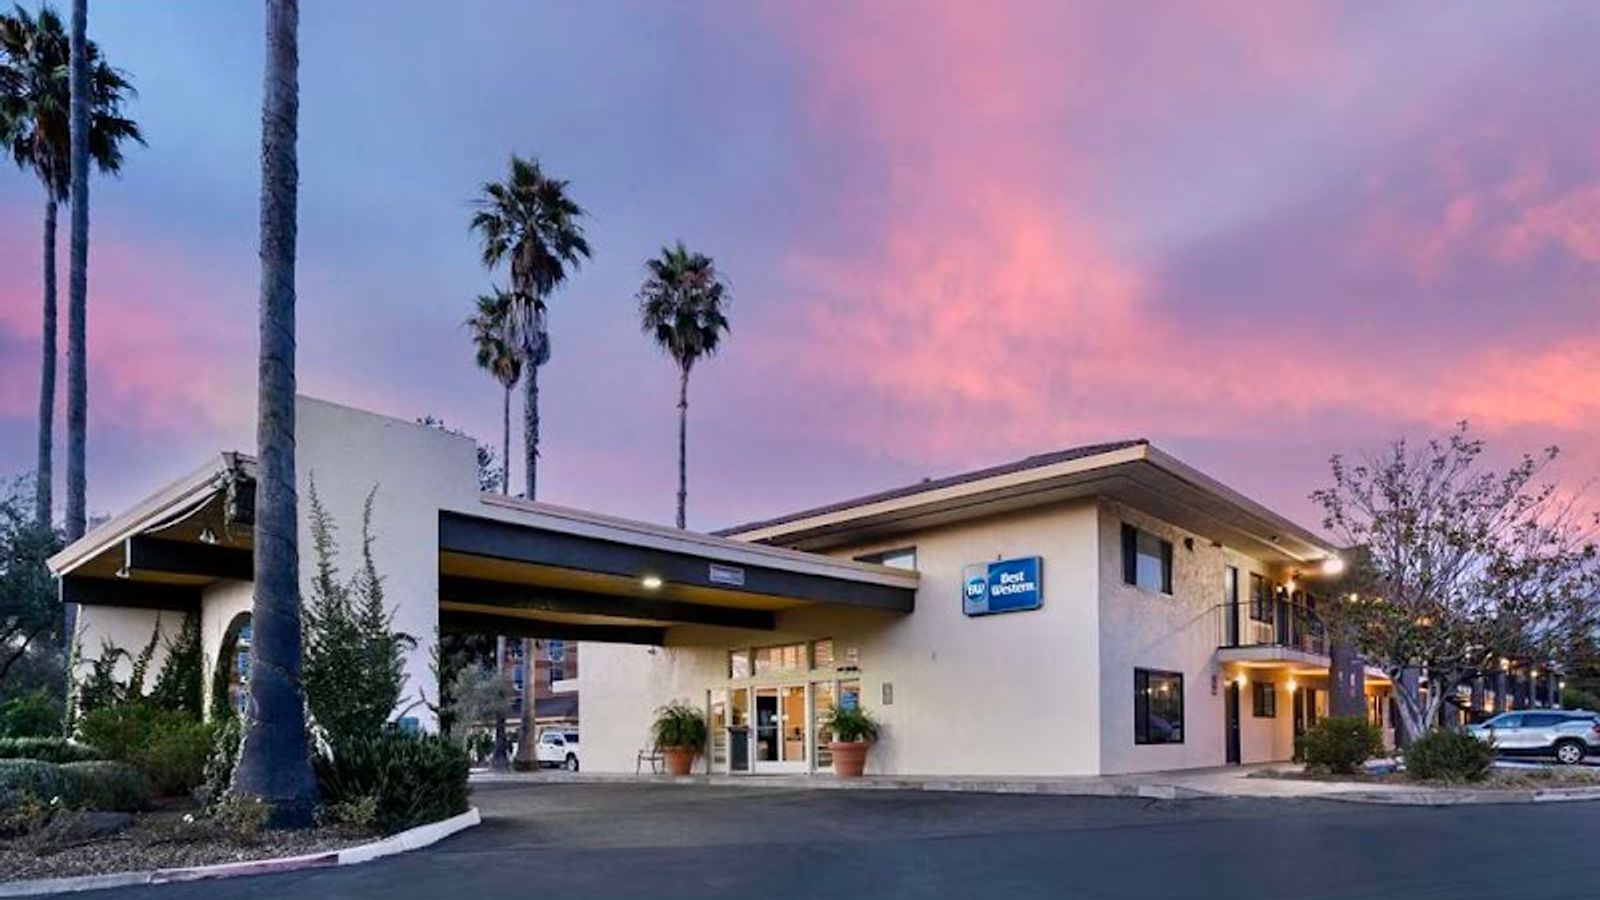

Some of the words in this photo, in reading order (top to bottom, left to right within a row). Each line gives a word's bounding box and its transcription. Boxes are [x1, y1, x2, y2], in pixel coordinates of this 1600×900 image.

[1001, 571, 1024, 583] Best
[967, 583, 985, 596] BW
[991, 582, 1035, 596] Western
